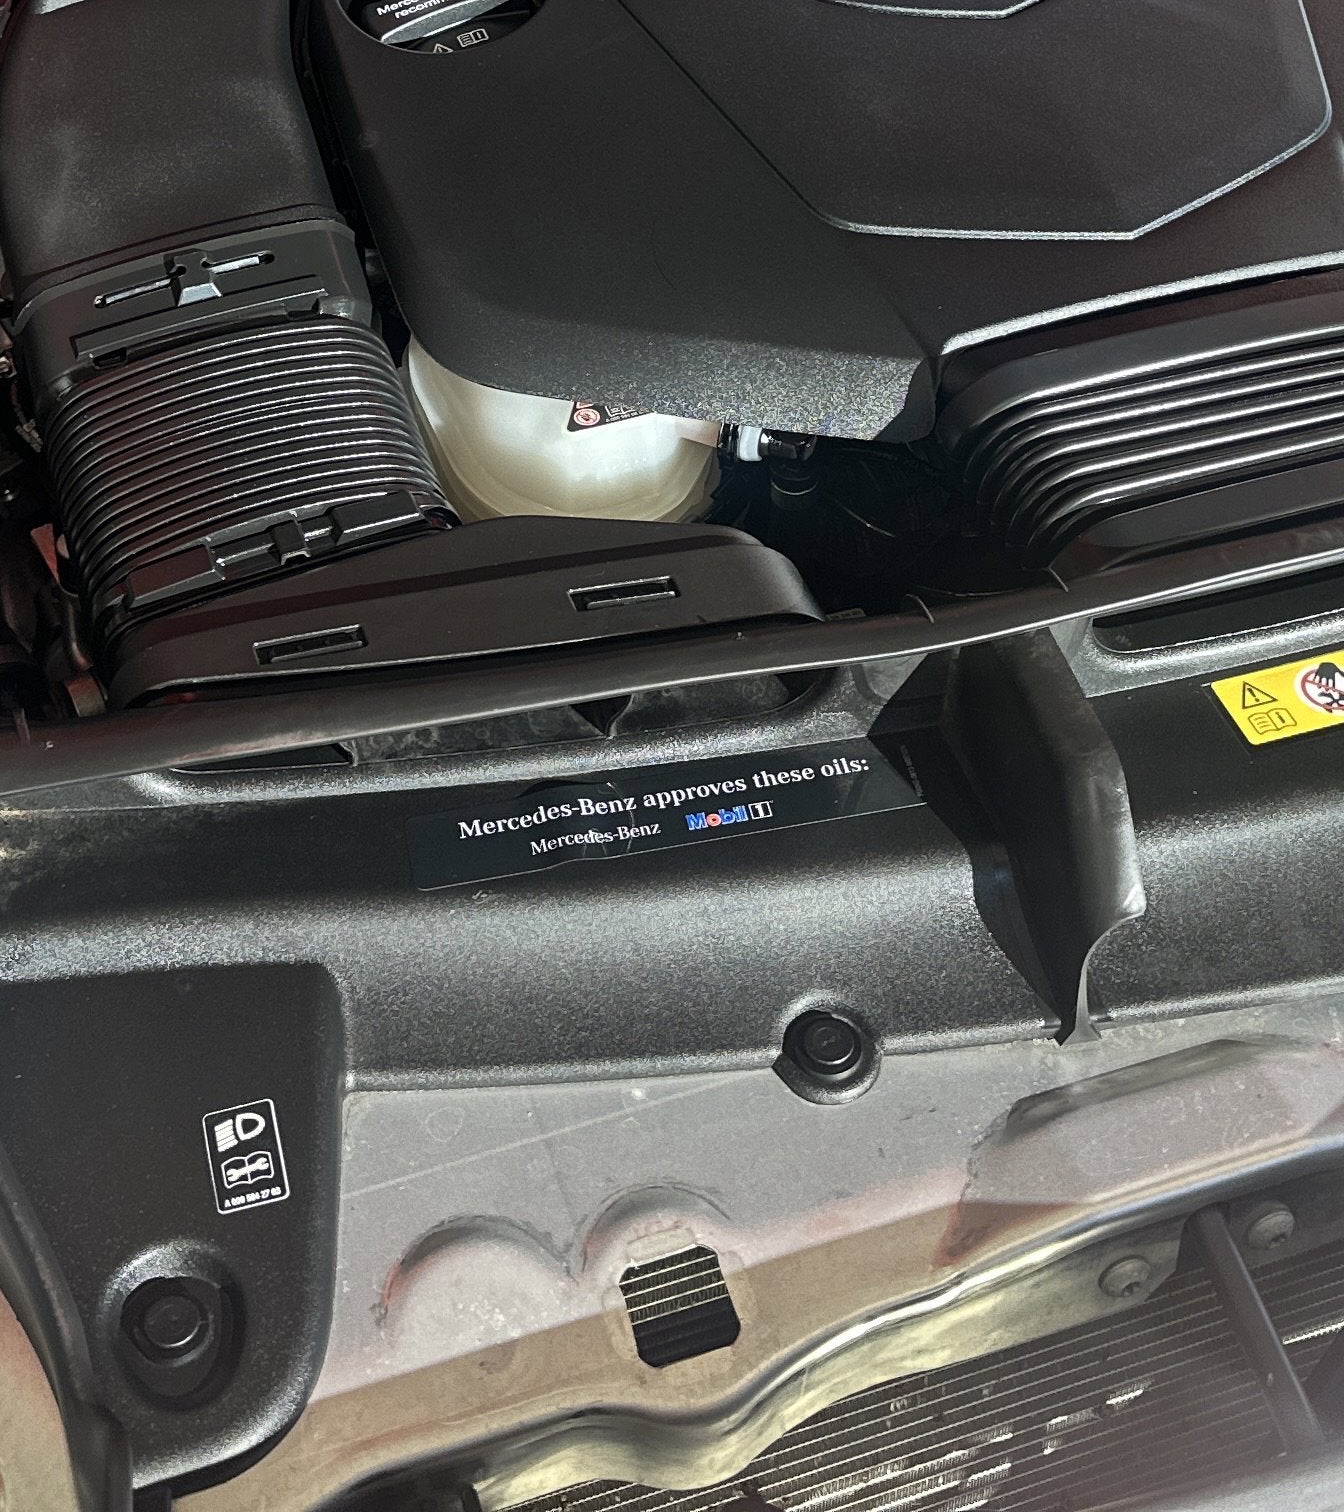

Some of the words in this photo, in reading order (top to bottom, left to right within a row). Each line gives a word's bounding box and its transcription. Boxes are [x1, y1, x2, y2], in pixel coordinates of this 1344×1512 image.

[458, 794, 638, 840] Mercedes-Benz
[642, 774, 747, 810] approves
[751, 764, 816, 795] these
[820, 756, 870, 779] oils:
[530, 821, 661, 857] Mercedes-Benz
[685, 805, 749, 831] Mobil
